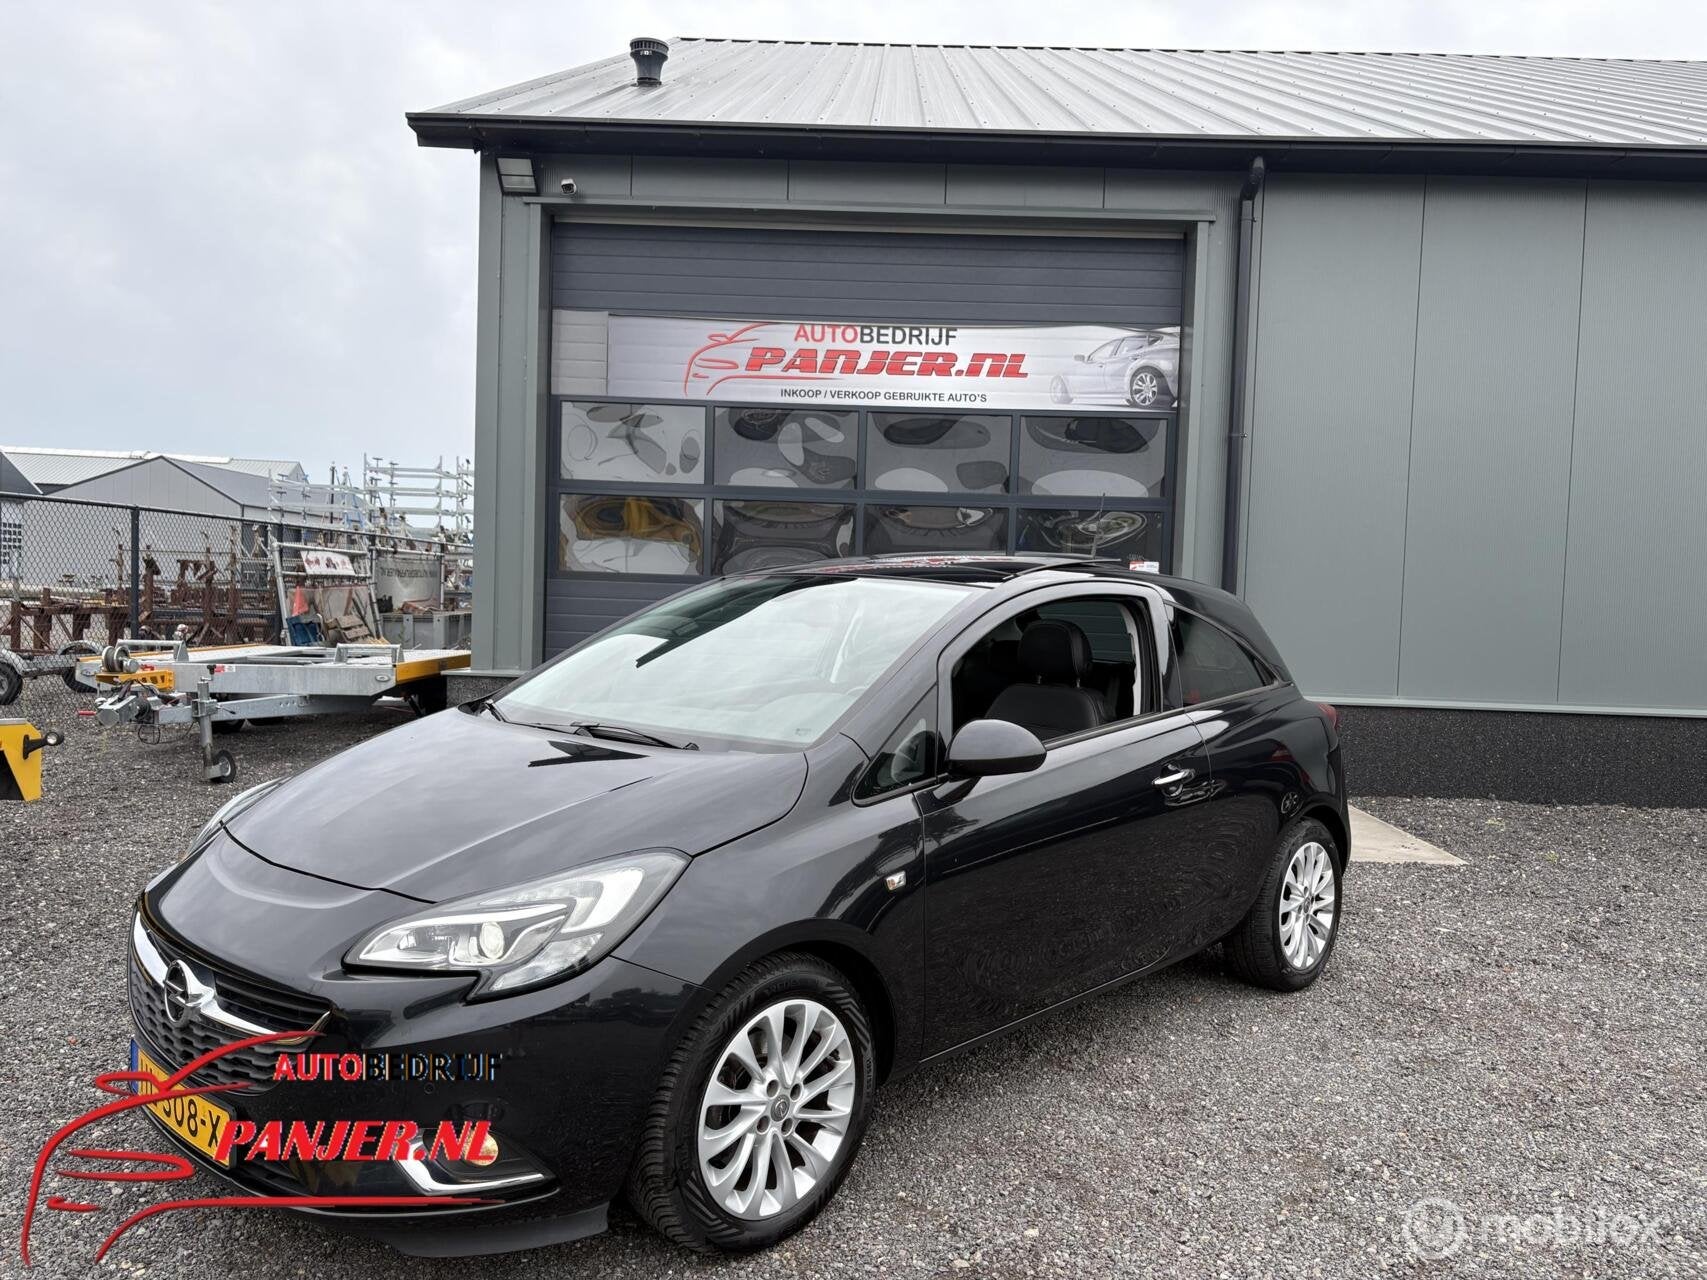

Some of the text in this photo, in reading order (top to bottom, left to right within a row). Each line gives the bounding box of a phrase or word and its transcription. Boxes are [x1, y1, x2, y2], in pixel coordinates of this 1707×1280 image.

[794, 324, 958, 346] AUTOBEDRIJF
[745, 346, 1029, 378] PANJER.NL
[780, 388, 822, 398] INKOOP
[830, 389, 881, 400] VERKOOP
[884, 390, 945, 402] GEBRUIKTE
[947, 392, 987, 403] AUTO'S
